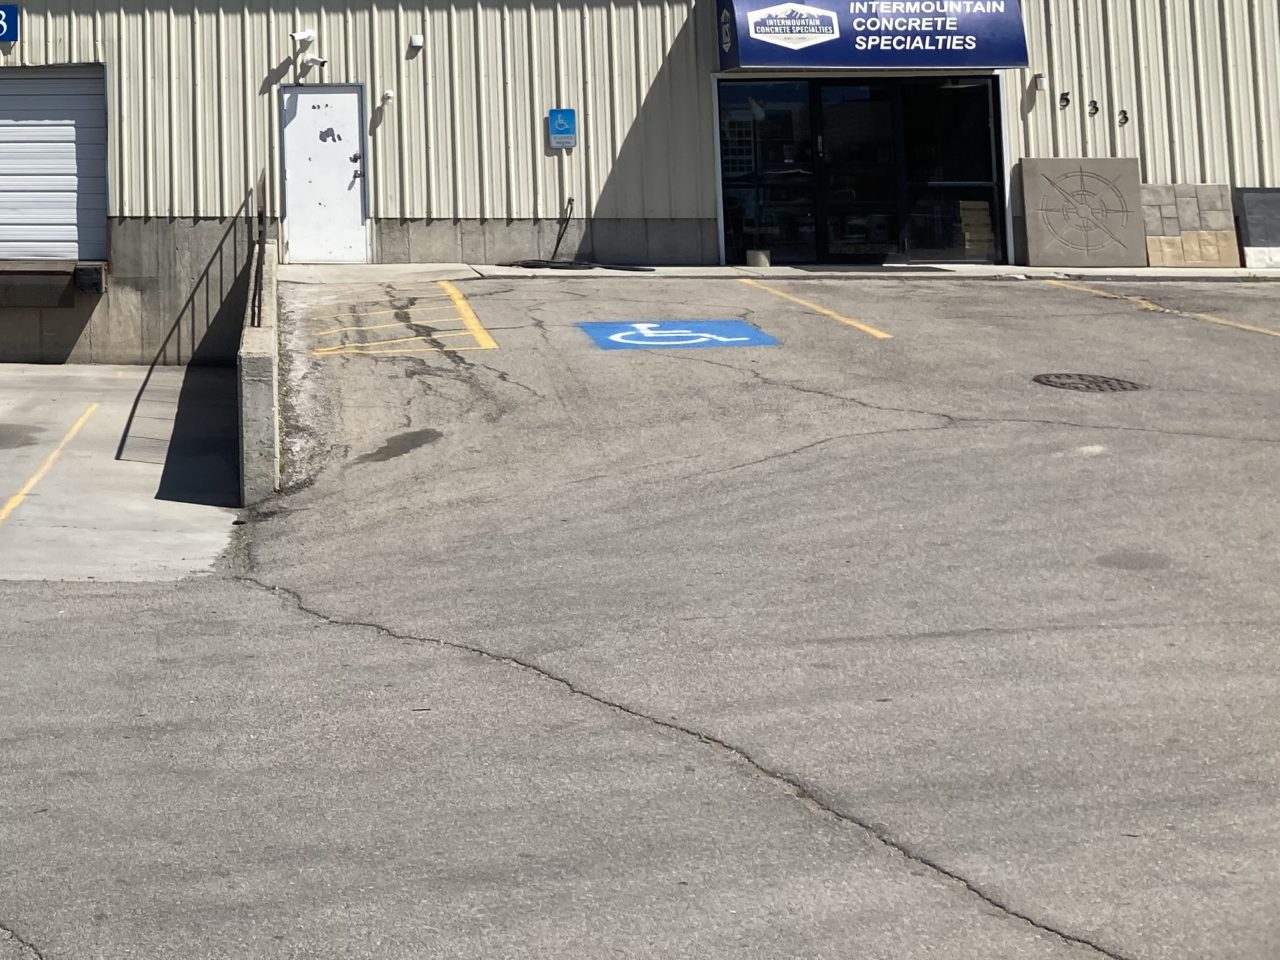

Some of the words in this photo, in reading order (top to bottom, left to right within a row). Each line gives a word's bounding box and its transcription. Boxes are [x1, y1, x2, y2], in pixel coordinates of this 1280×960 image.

[849, 0, 1005, 14] INTERMOUNTAIN
[756, 25, 791, 34] CONCRETE
[791, 25, 833, 34] SPECIALTIES
[766, 19, 821, 27] INTERMOUNTAIN
[852, 17, 958, 31] CONCRETE
[854, 35, 977, 50] SPECIALTIES
